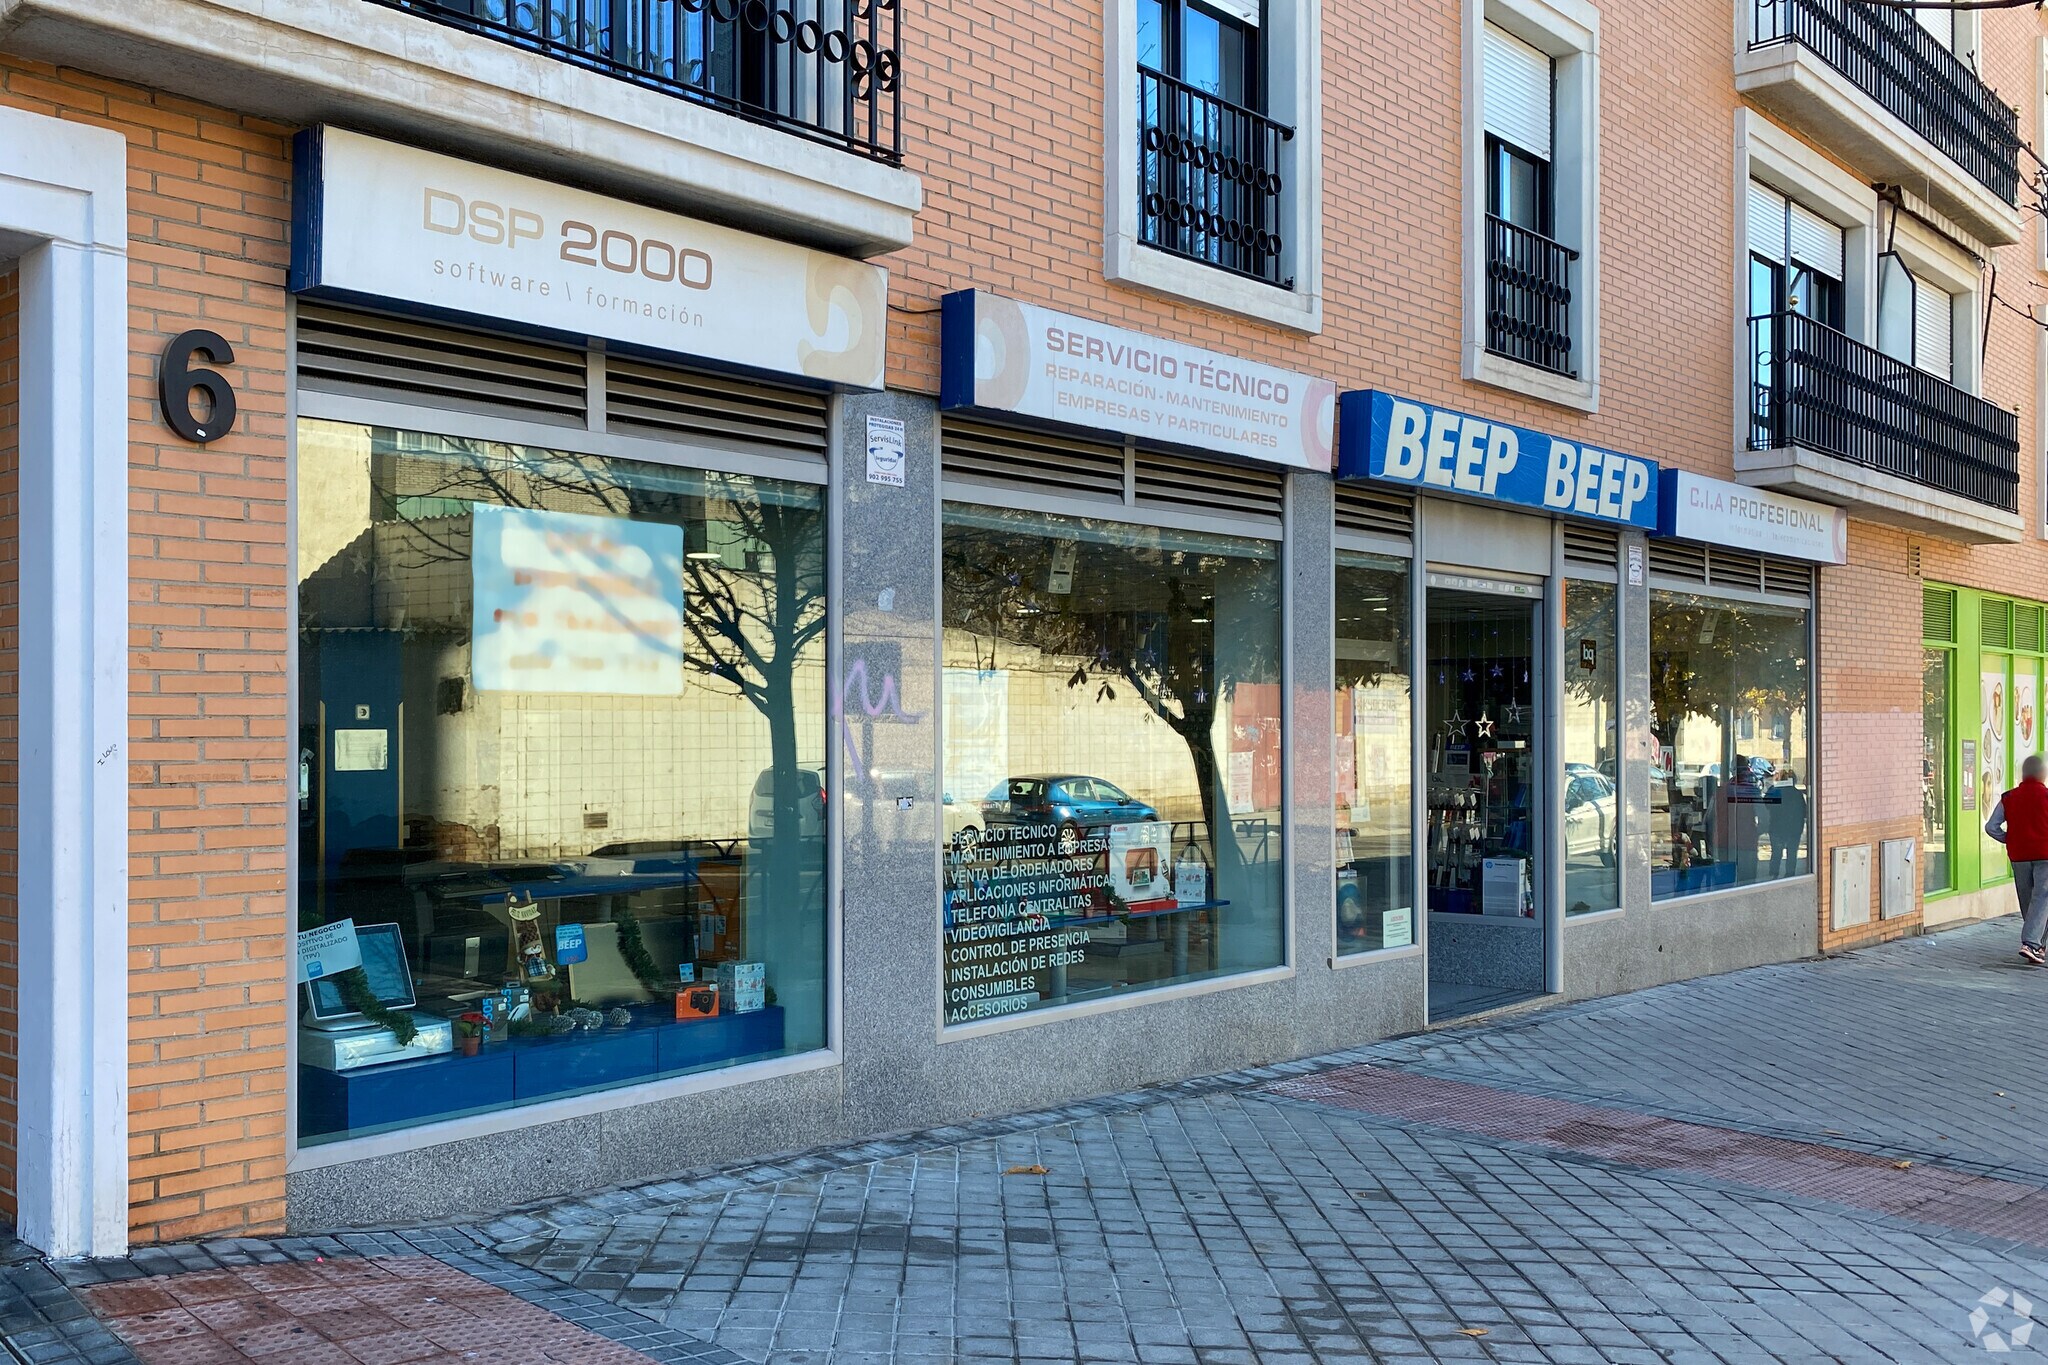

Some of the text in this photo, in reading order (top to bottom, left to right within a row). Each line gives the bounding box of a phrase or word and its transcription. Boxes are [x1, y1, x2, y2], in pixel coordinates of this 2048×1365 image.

[424, 187, 713, 291] DSP 2000
[433, 259, 550, 296] software
[586, 287, 703, 327] formación
[1046, 327, 1289, 405] SERVICIO TÉCNICO
[159, 329, 236, 443] 6
[1045, 362, 1156, 400] REPARACIÓN
[1166, 390, 1288, 428] MANTENIMIENTO
[1057, 391, 1278, 448] EMPRESAS Y PARTICULARES
[1383, 400, 1649, 521] BEEP BEEP
[869, 473, 880, 481] 902
[1729, 496, 1824, 533] PROFESIONAL
[951, 824, 1057, 845] SERVICIO TECNICO
[951, 843, 1045, 865] MANTENIMIENTO
[1047, 843, 1056, 856] A
[951, 867, 990, 885] VENTA
[992, 865, 1008, 880] DE
[1010, 857, 1094, 878] ORDENADORES
[950, 881, 1036, 904] APLICACIONES
[1038, 873, 1117, 894] INFORMÁTICAS
[951, 901, 1016, 923] TELEFONÍA
[1018, 893, 1092, 915] CENTRALITAS
[309, 922, 345, 937] NEGOCIO!
[325, 932, 334, 940] DE
[558, 938, 582, 951] BEEP
[951, 917, 1051, 943] VIDEOVIGILANCIA
[302, 936, 348, 954] DIGITALIZADO
[951, 942, 1008, 963] CONTROL
[1011, 939, 1026, 955] DE
[1029, 930, 1091, 952] PRESENCIA
[951, 956, 1028, 983] INSTALACIÓN
[1031, 955, 1046, 970] DE
[1049, 949, 1085, 968] REDES
[951, 976, 1035, 1002] CONSUMIBLES
[951, 996, 1028, 1022] ACCESORIOS
